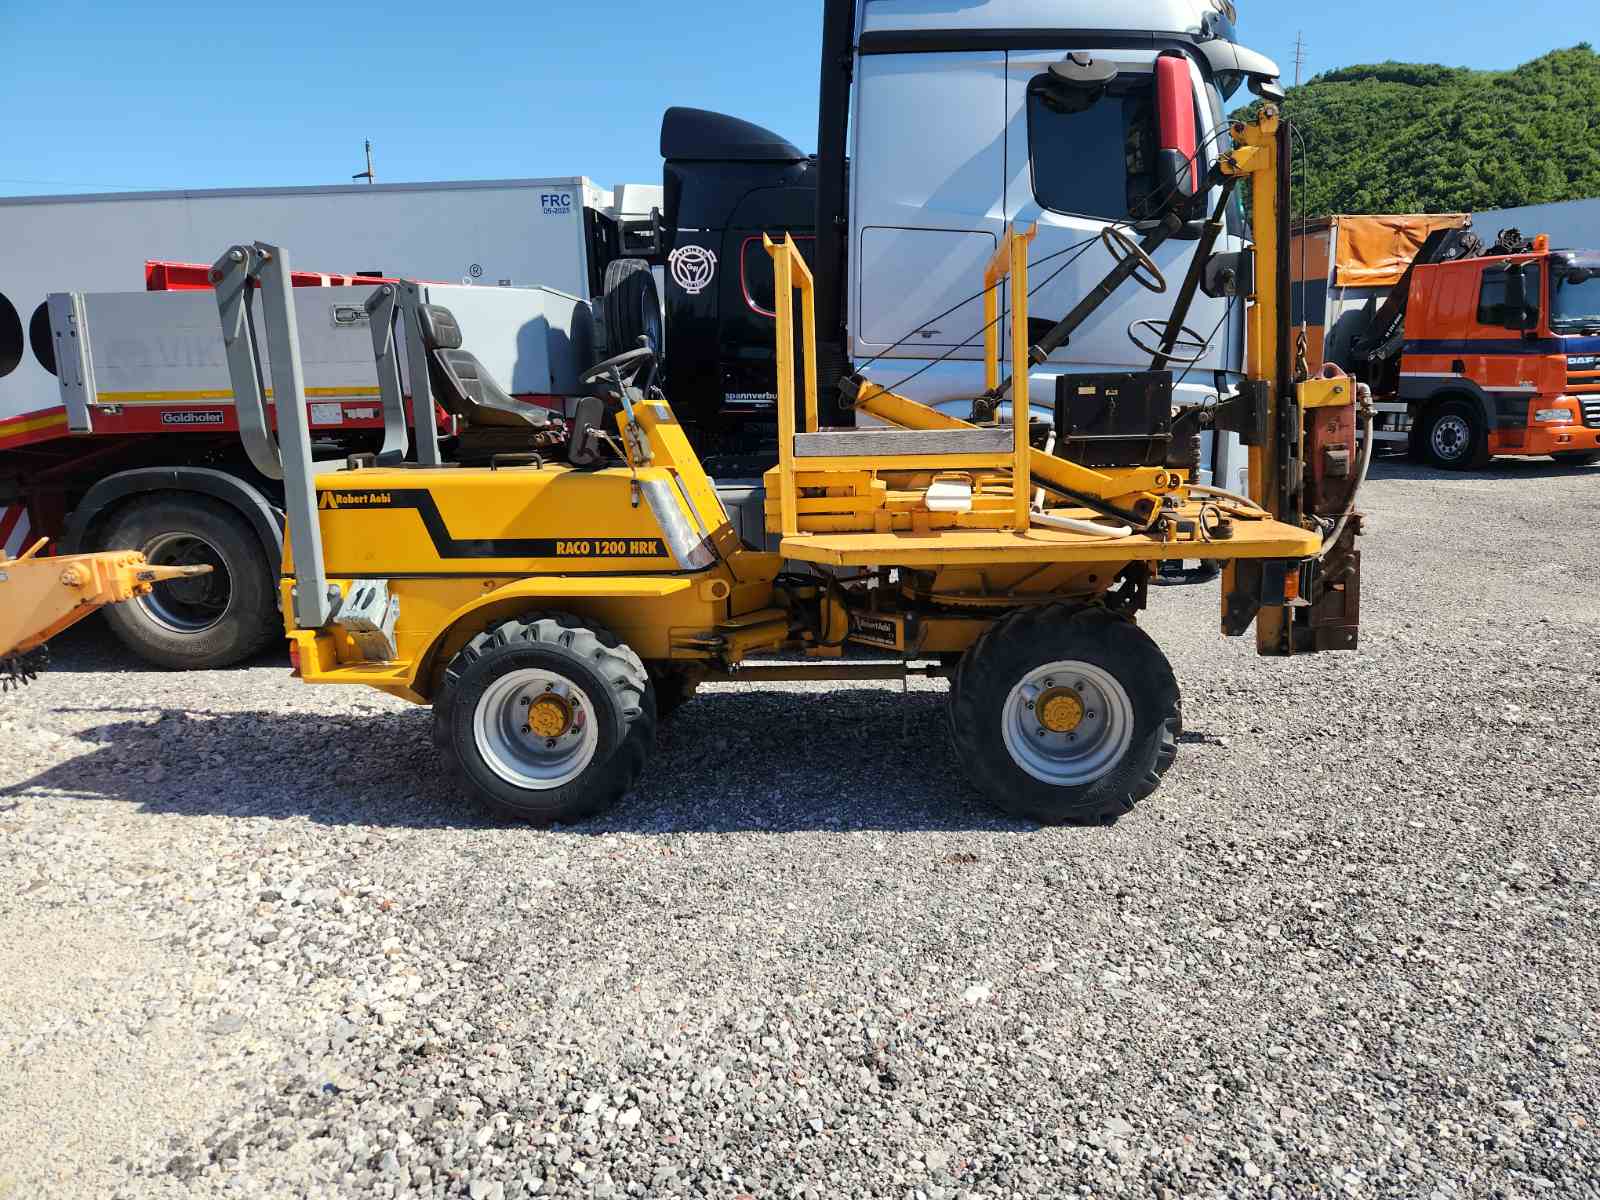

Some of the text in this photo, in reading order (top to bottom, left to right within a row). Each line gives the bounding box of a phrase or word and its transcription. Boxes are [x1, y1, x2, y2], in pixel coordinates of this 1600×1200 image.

[541, 194, 571, 207] FRC
[1567, 356, 1594, 365] DAF
[335, 492, 391, 504] Robert Aebi
[556, 541, 657, 554] RACO 1200 HRK
